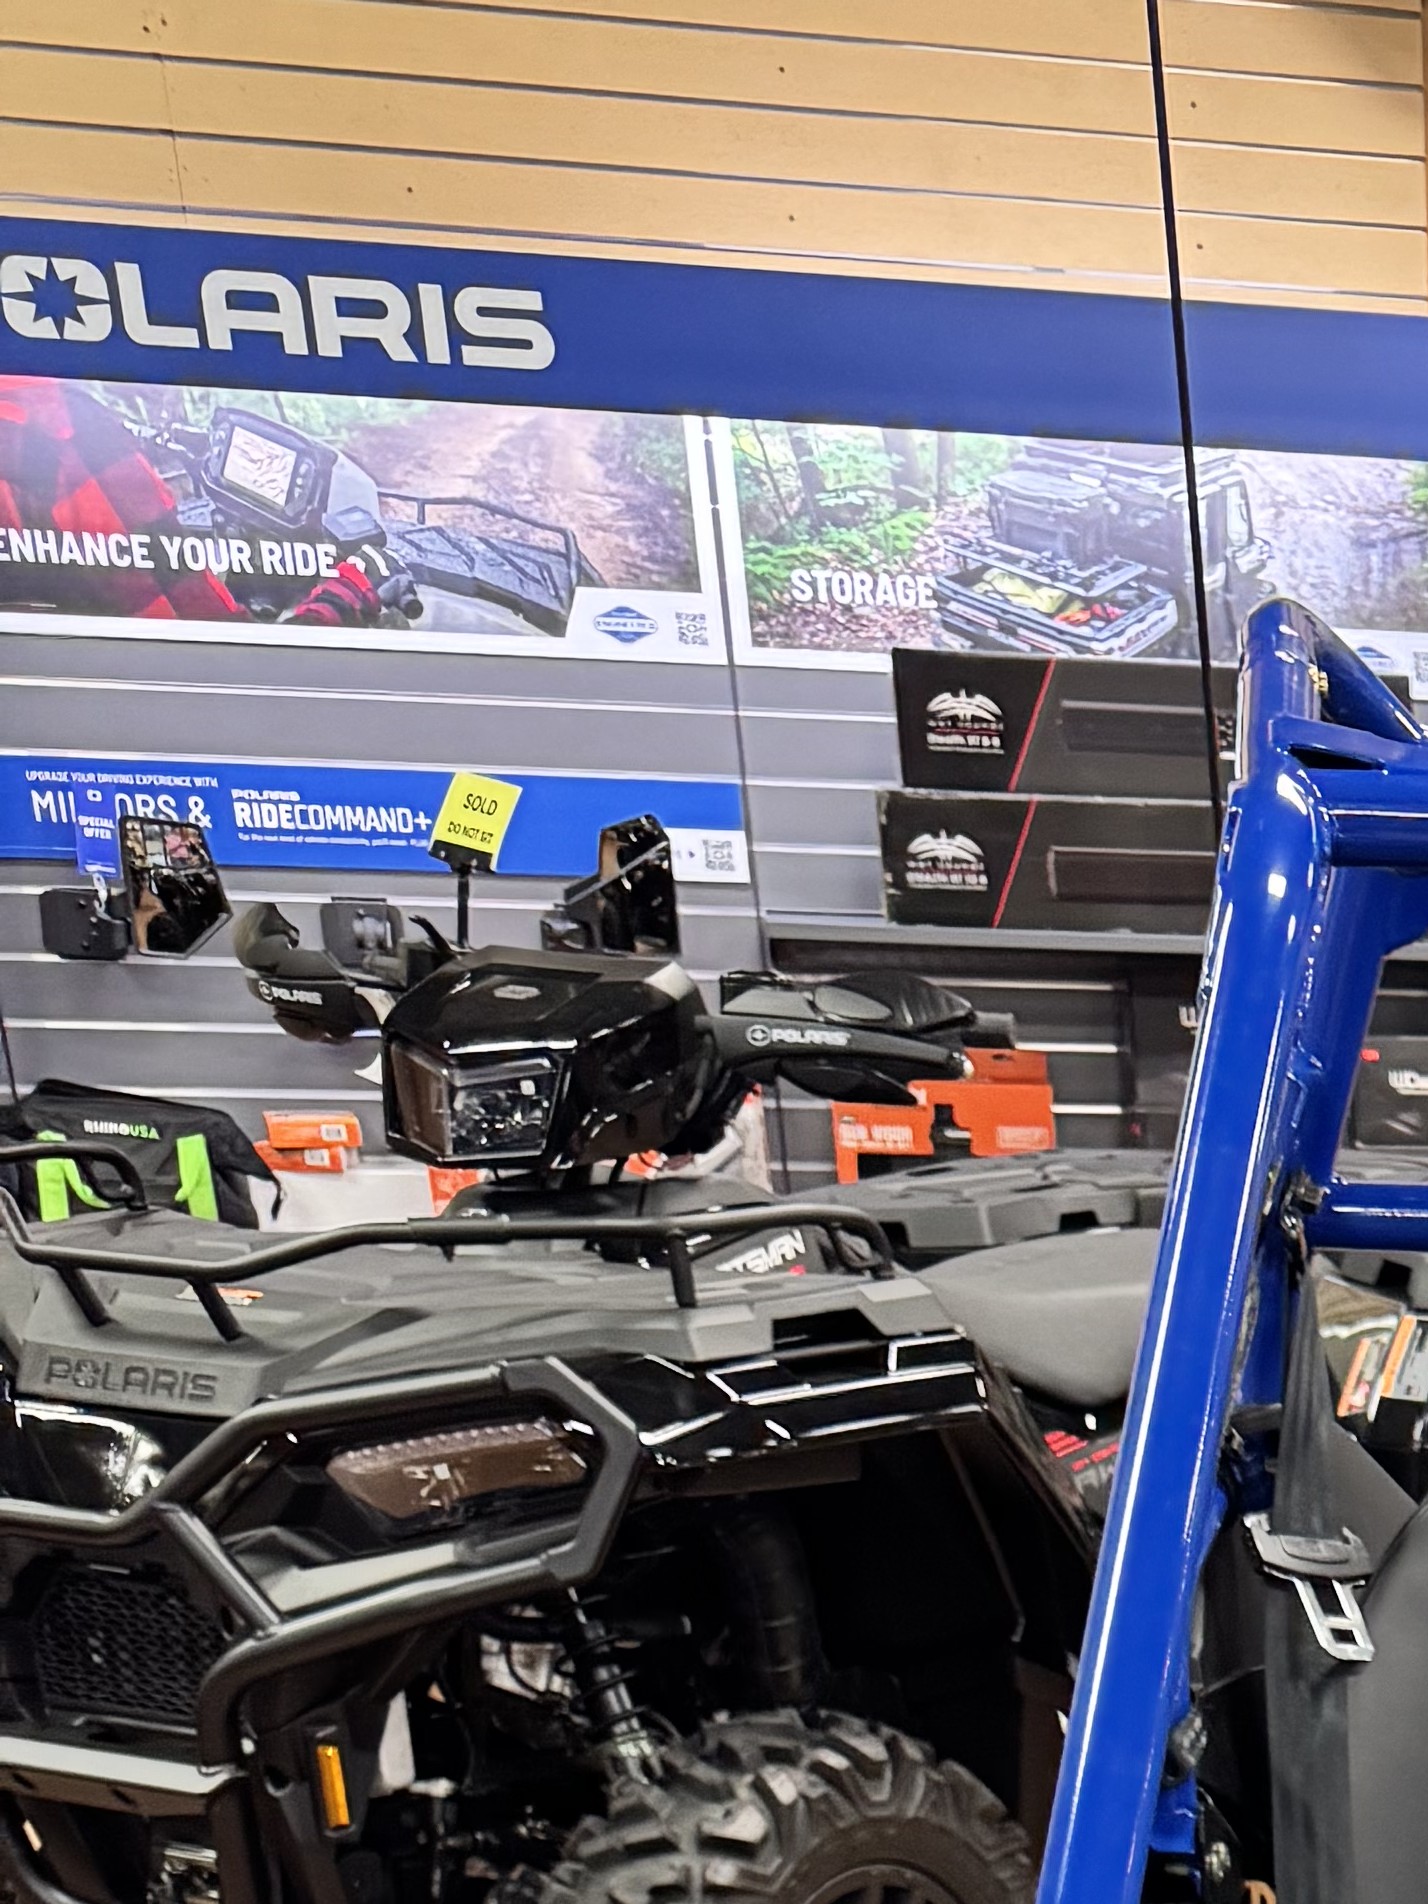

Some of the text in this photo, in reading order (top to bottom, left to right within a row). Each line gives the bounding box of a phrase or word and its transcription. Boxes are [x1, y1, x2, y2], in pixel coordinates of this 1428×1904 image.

[159, 534, 254, 575] YOUR
[259, 539, 341, 578] RIDE
[790, 568, 938, 609] STORAGE
[30, 789, 181, 824] MIORS
[233, 801, 433, 834] RIDECOMMAND+
[462, 792, 498, 816] SOLD
[771, 1027, 851, 1047] POLARIS
[715, 1228, 805, 1273] TSMAN
[44, 1355, 219, 1401] POLARIS
